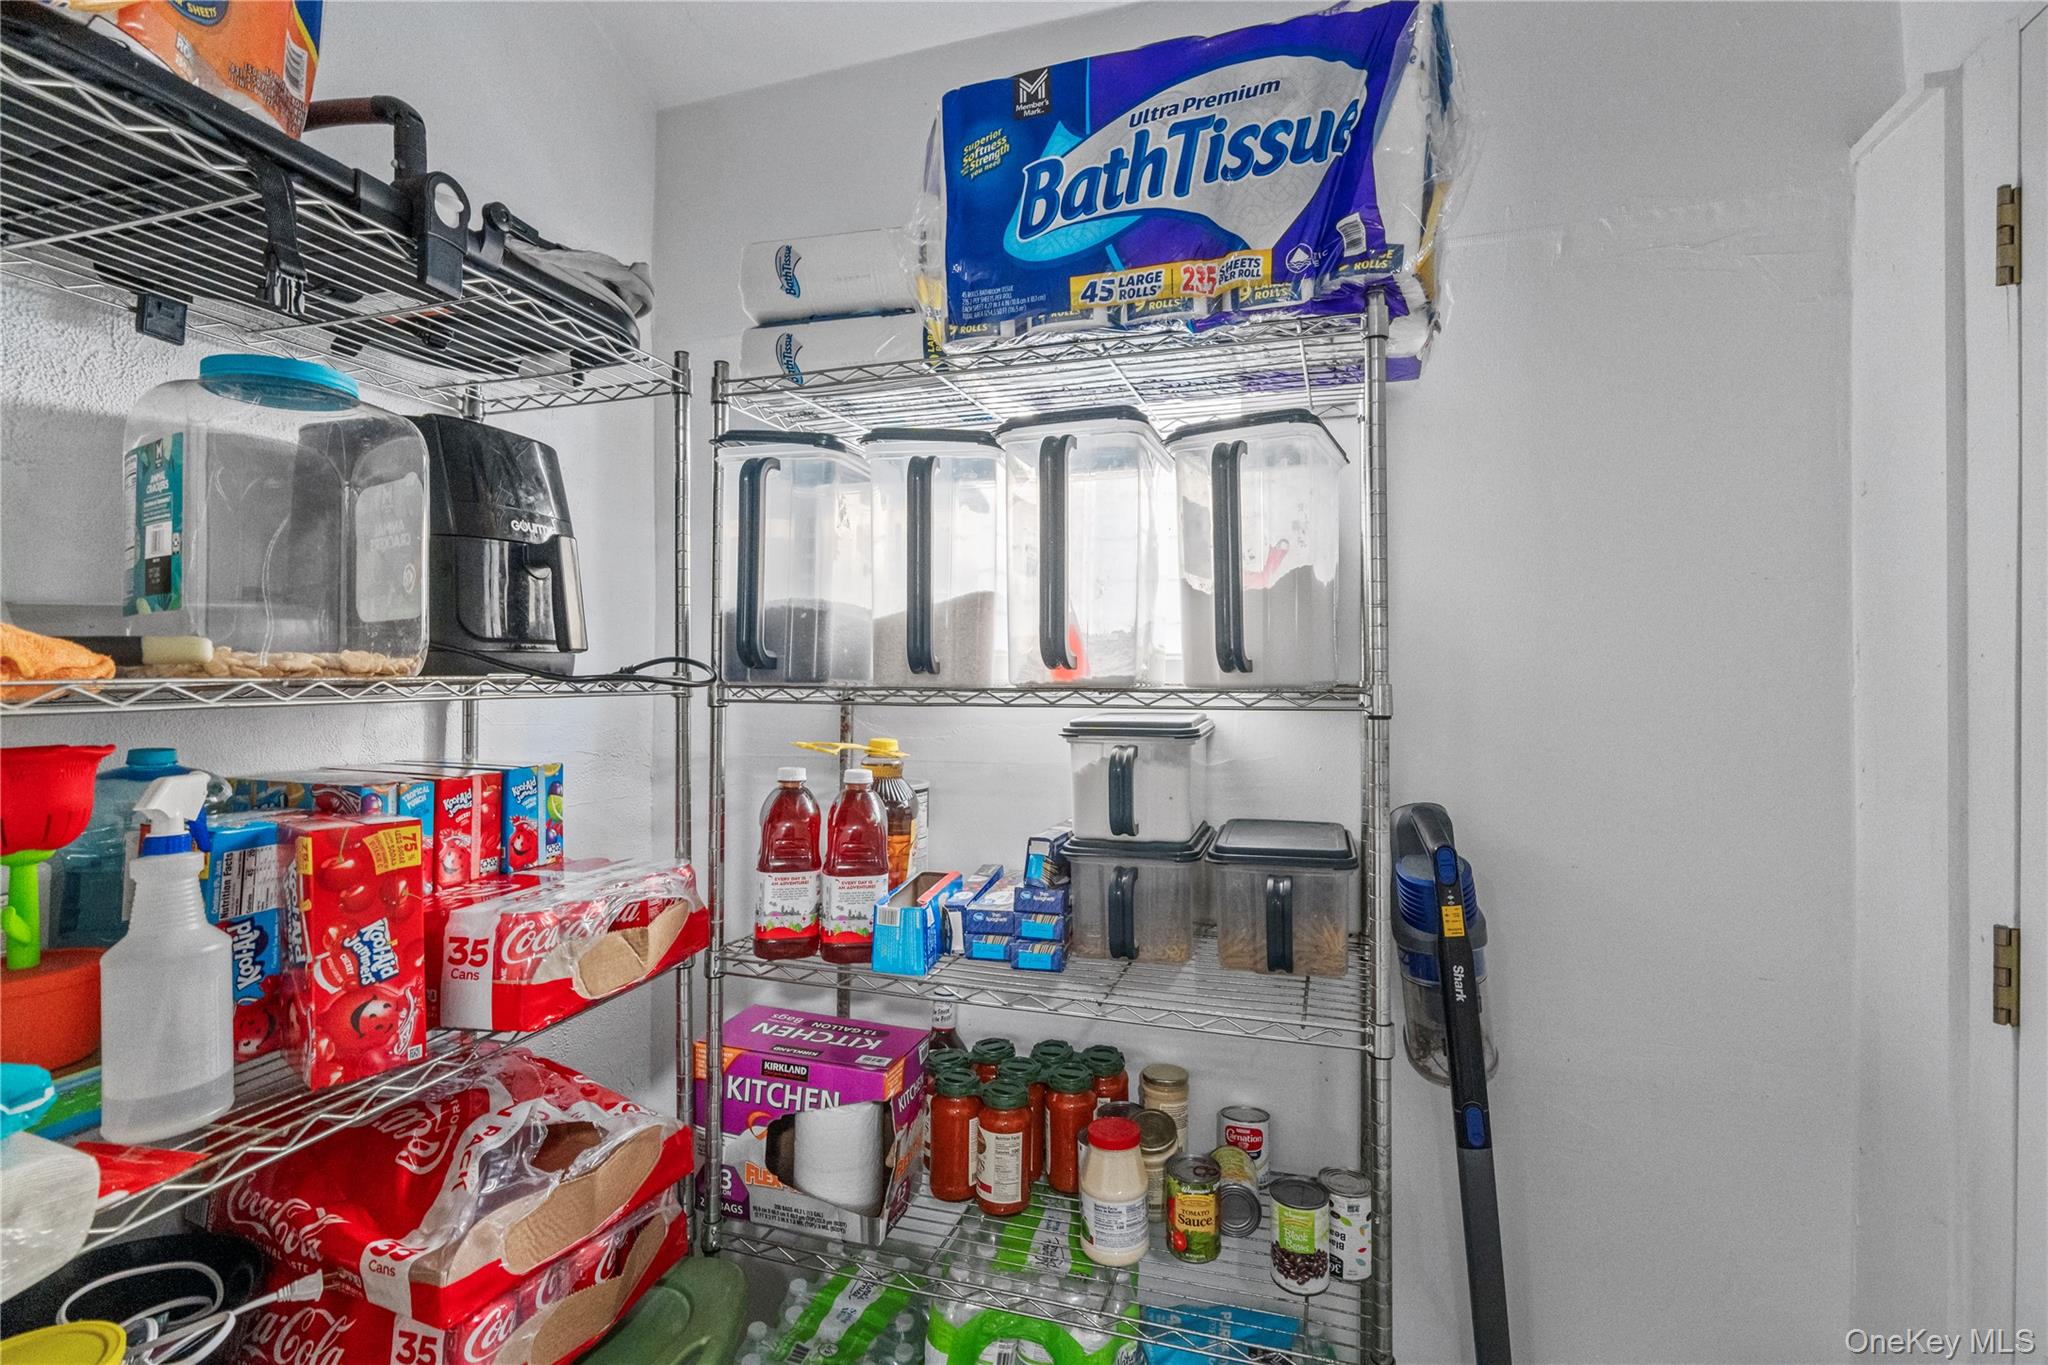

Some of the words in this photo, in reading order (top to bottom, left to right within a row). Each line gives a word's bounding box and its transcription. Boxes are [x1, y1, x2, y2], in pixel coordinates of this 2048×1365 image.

[1015, 99, 1049, 112] Member's
[1129, 104, 1179, 128] Ultra
[1182, 80, 1280, 114] Premium
[1219, 257, 1261, 276] SHEETS
[1118, 270, 1163, 290] LARGE
[1218, 271, 1236, 286] PER
[1238, 267, 1261, 281] ROLL
[1080, 279, 1115, 304] 45
[959, 322, 988, 333] ROLLS
[402, 785, 430, 803] TROPICAL
[223, 852, 234, 877] Facts
[219, 879, 232, 920] Nutrition
[227, 921, 261, 990] Kool-Aid
[361, 917, 400, 983] Kool-Aid
[447, 936, 489, 968] 35
[344, 936, 376, 987] Jammers
[450, 968, 480, 981] Cans
[1453, 964, 1466, 1003] Shark
[772, 1012, 804, 1024] Bags
[811, 1020, 867, 1035] GALLON
[751, 1021, 883, 1051] KITCHEN
[763, 1061, 808, 1076] KIRKLAND
[726, 1075, 841, 1112] KITCHEN
[1226, 1128, 1263, 1143] Carnation
[722, 1202, 744, 1215] AGS
[1181, 1208, 1210, 1217] TOMATO
[1177, 1213, 1213, 1227] Sauce
[368, 1259, 396, 1277] Cans
[396, 1331, 438, 1365] 35
